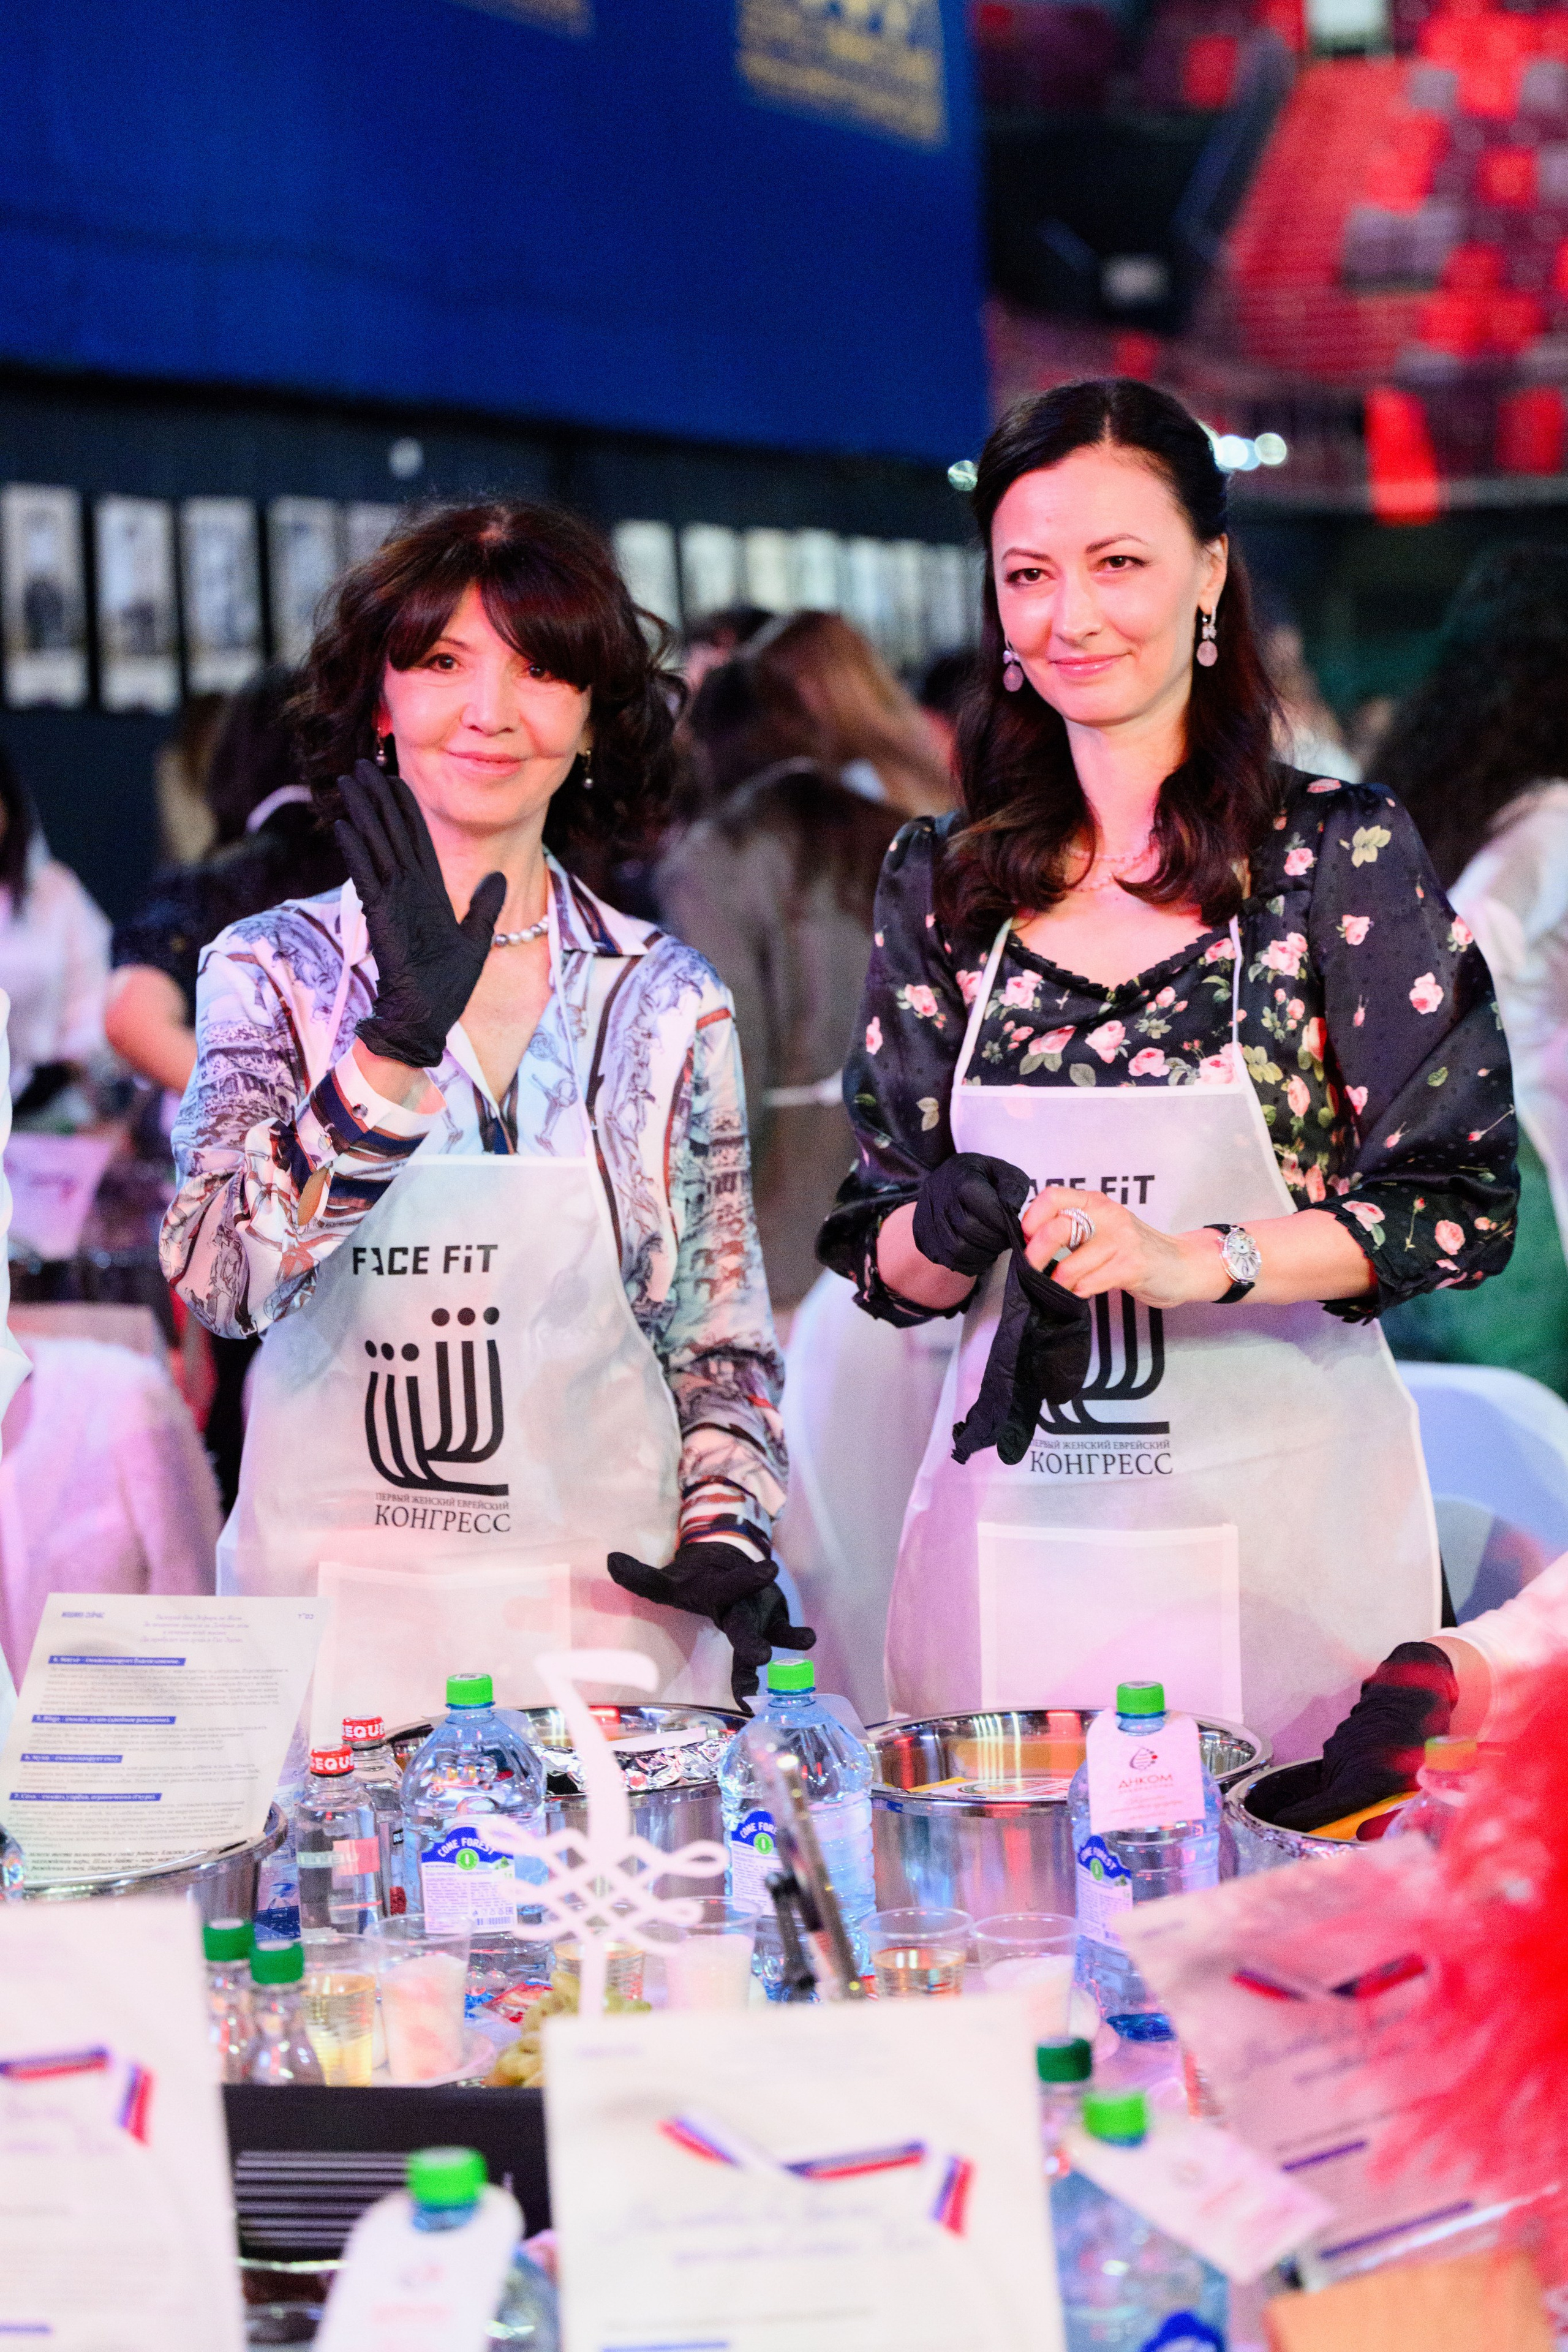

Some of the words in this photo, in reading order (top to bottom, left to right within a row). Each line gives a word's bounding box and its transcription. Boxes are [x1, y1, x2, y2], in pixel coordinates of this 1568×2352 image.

[1101, 1175, 1155, 1205] FiT
[352, 1246, 429, 1275] FACE
[443, 1244, 498, 1274] FiT
[1063, 1440, 1110, 1450] ЖЕНСКИЙ
[1114, 1439, 1170, 1450] ЕВРЕЙСКИЙ
[1030, 1450, 1173, 1475] КОНГРЕСС
[376, 1492, 410, 1503] ПЕРВЫЙ
[412, 1495, 454, 1507] ЖЕНСКИЙ
[458, 1499, 510, 1510] ЕВРЕЙСКИЙ
[375, 1504, 511, 1533] КОНГРЕСС
[437, 1839, 459, 1857] CONE
[461, 1838, 496, 1855] FOREST
